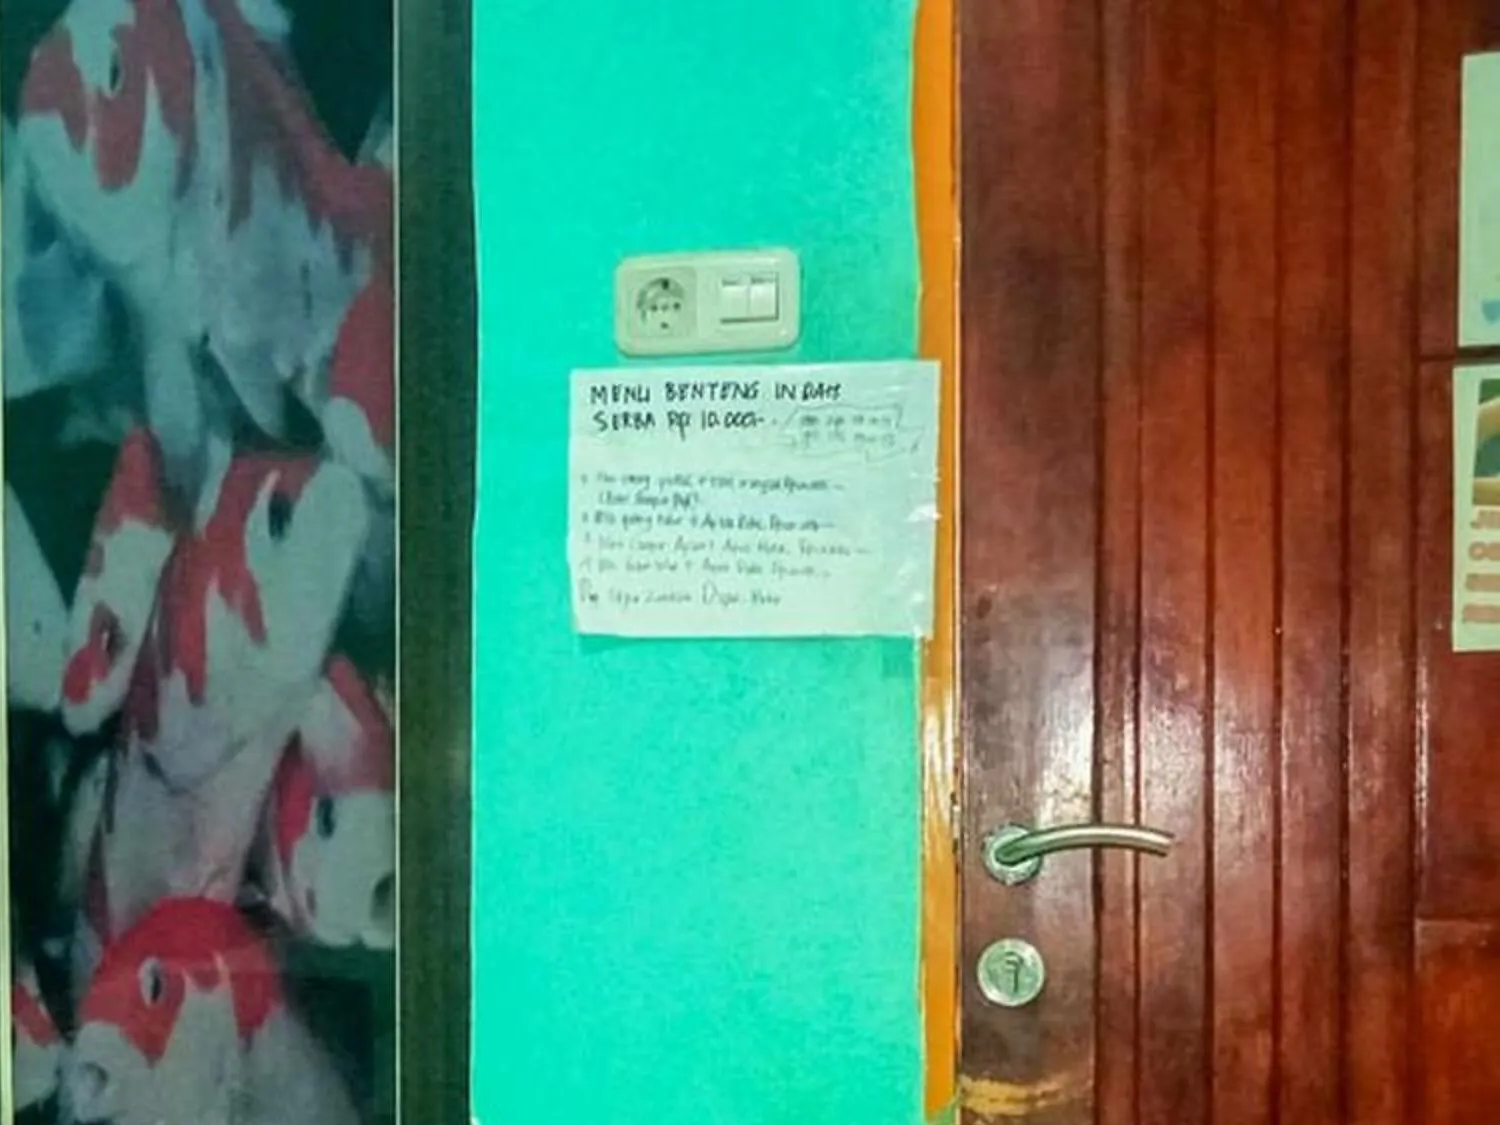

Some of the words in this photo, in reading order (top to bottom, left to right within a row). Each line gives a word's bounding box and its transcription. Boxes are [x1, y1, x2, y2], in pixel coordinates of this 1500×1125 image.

[590, 384, 651, 404] MENU
[664, 380, 760, 402] BENTENG
[592, 410, 656, 432] SERBA
